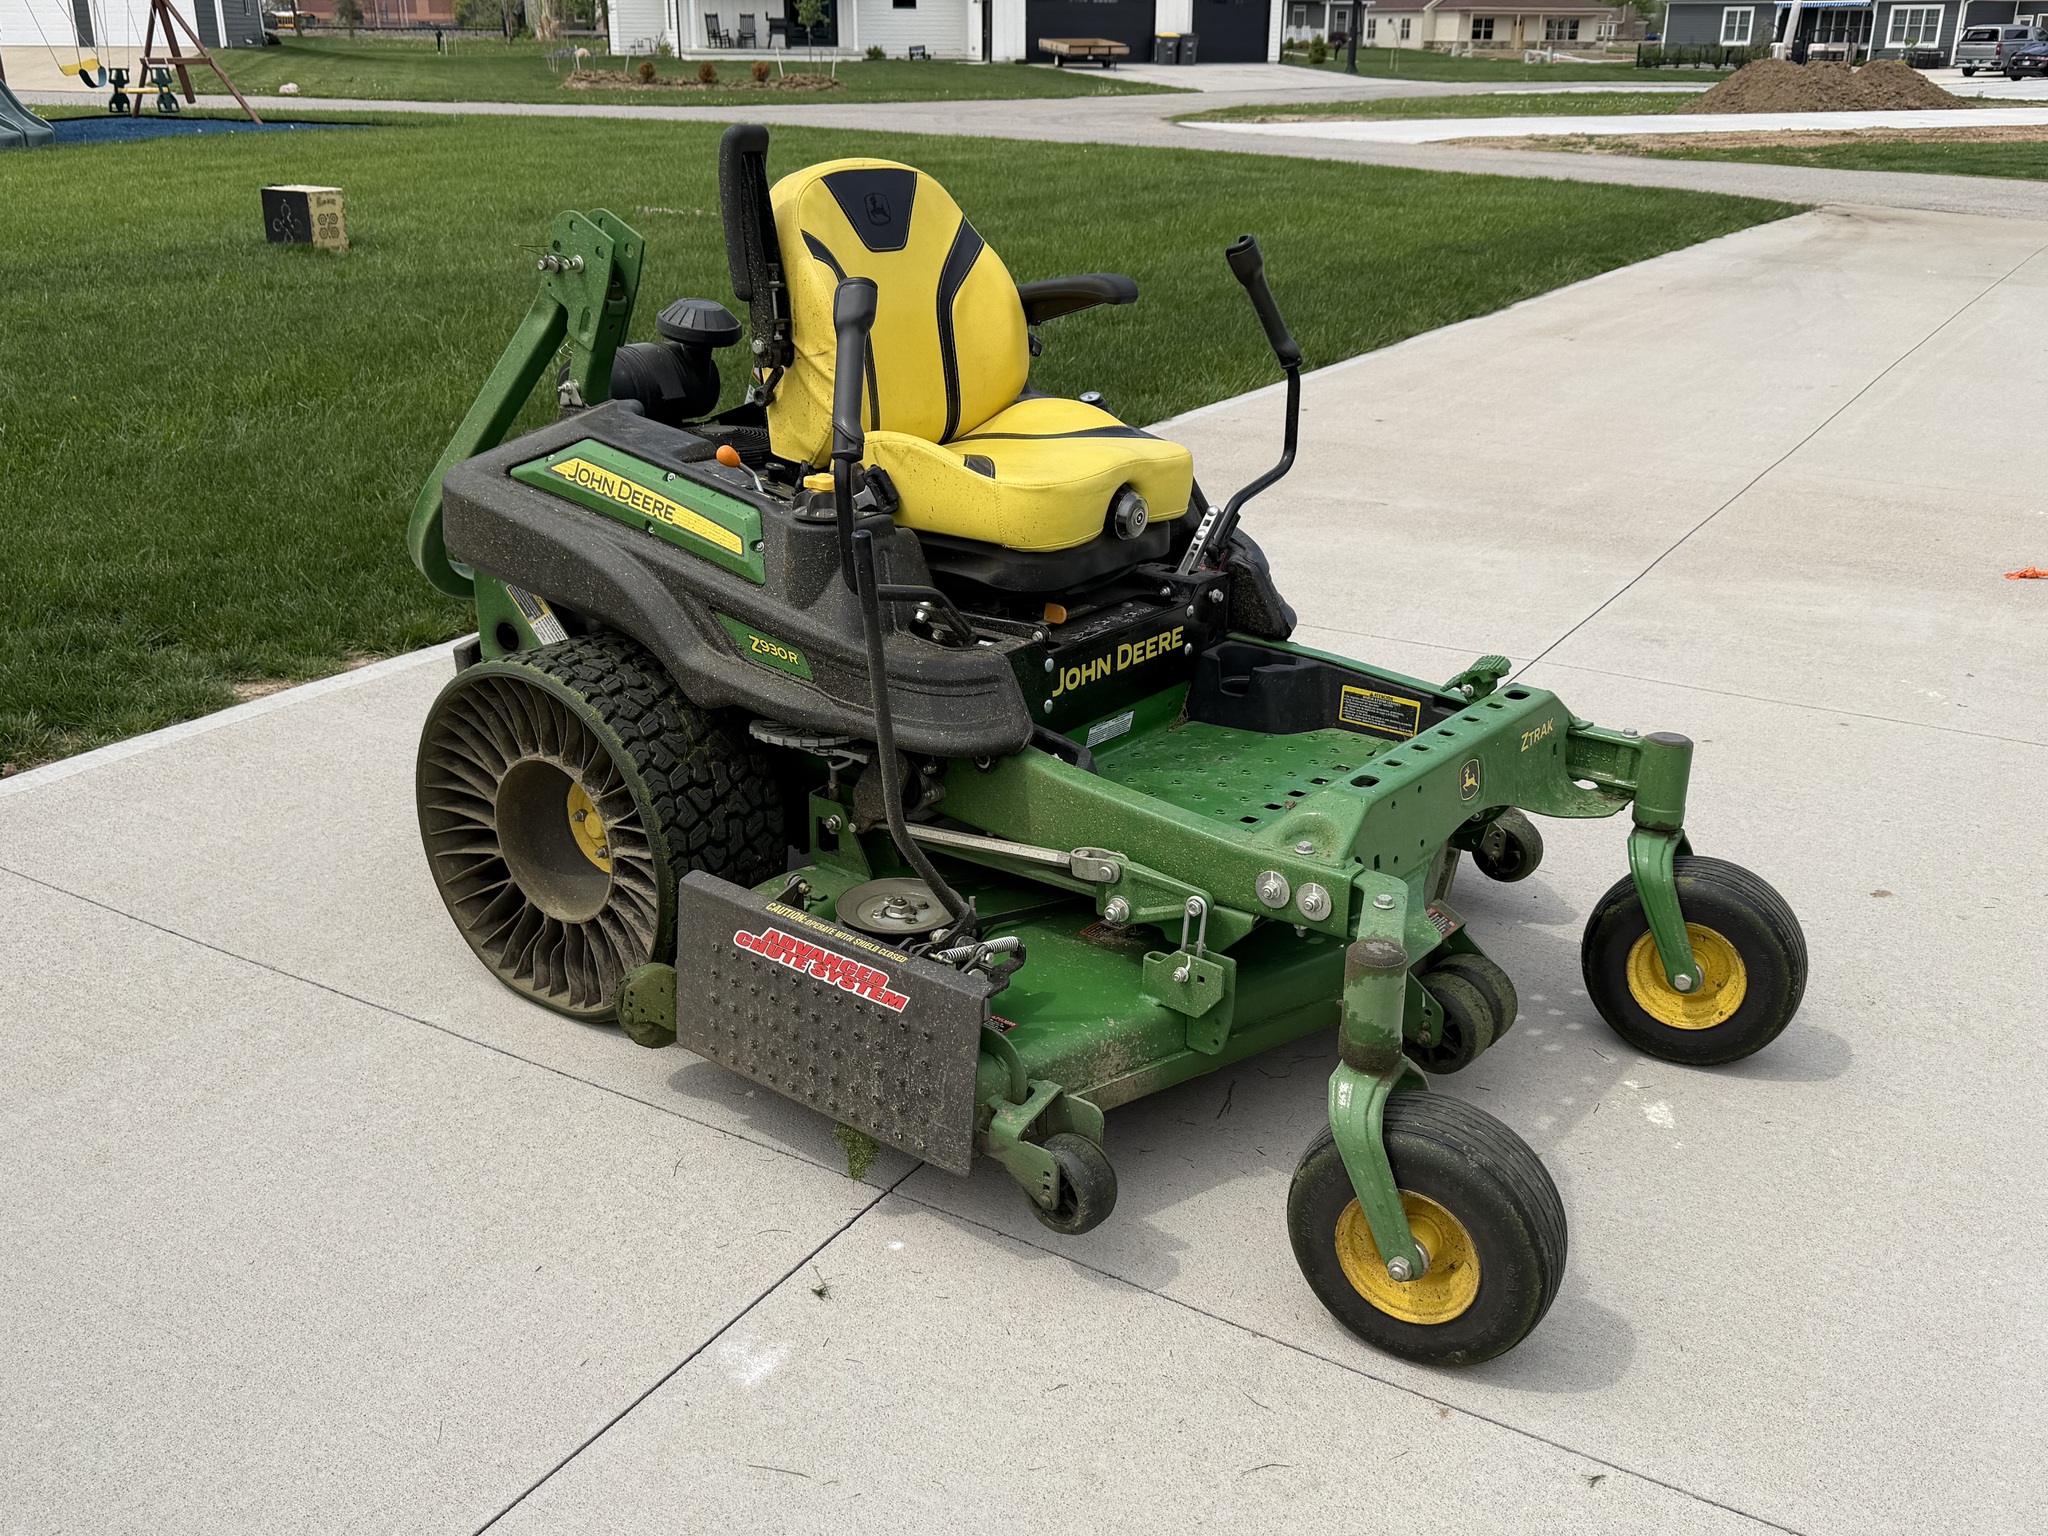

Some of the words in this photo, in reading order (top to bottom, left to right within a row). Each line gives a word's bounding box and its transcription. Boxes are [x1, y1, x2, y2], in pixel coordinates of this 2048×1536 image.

[568, 462, 615, 495] JOHN
[617, 480, 676, 522] DEERE
[1052, 653, 1111, 698] JOHN
[1116, 625, 1184, 672] DEERE
[1520, 717, 1554, 753] ZTRAK
[762, 929, 889, 988] ADVANCED
[805, 919, 837, 935] OPERATE
[834, 930, 857, 942] WITH
[852, 938, 880, 953] SHIELD
[877, 948, 909, 963] CLOSED
[735, 931, 809, 971] CHUTE
[810, 962, 908, 1011] SYSTEM
